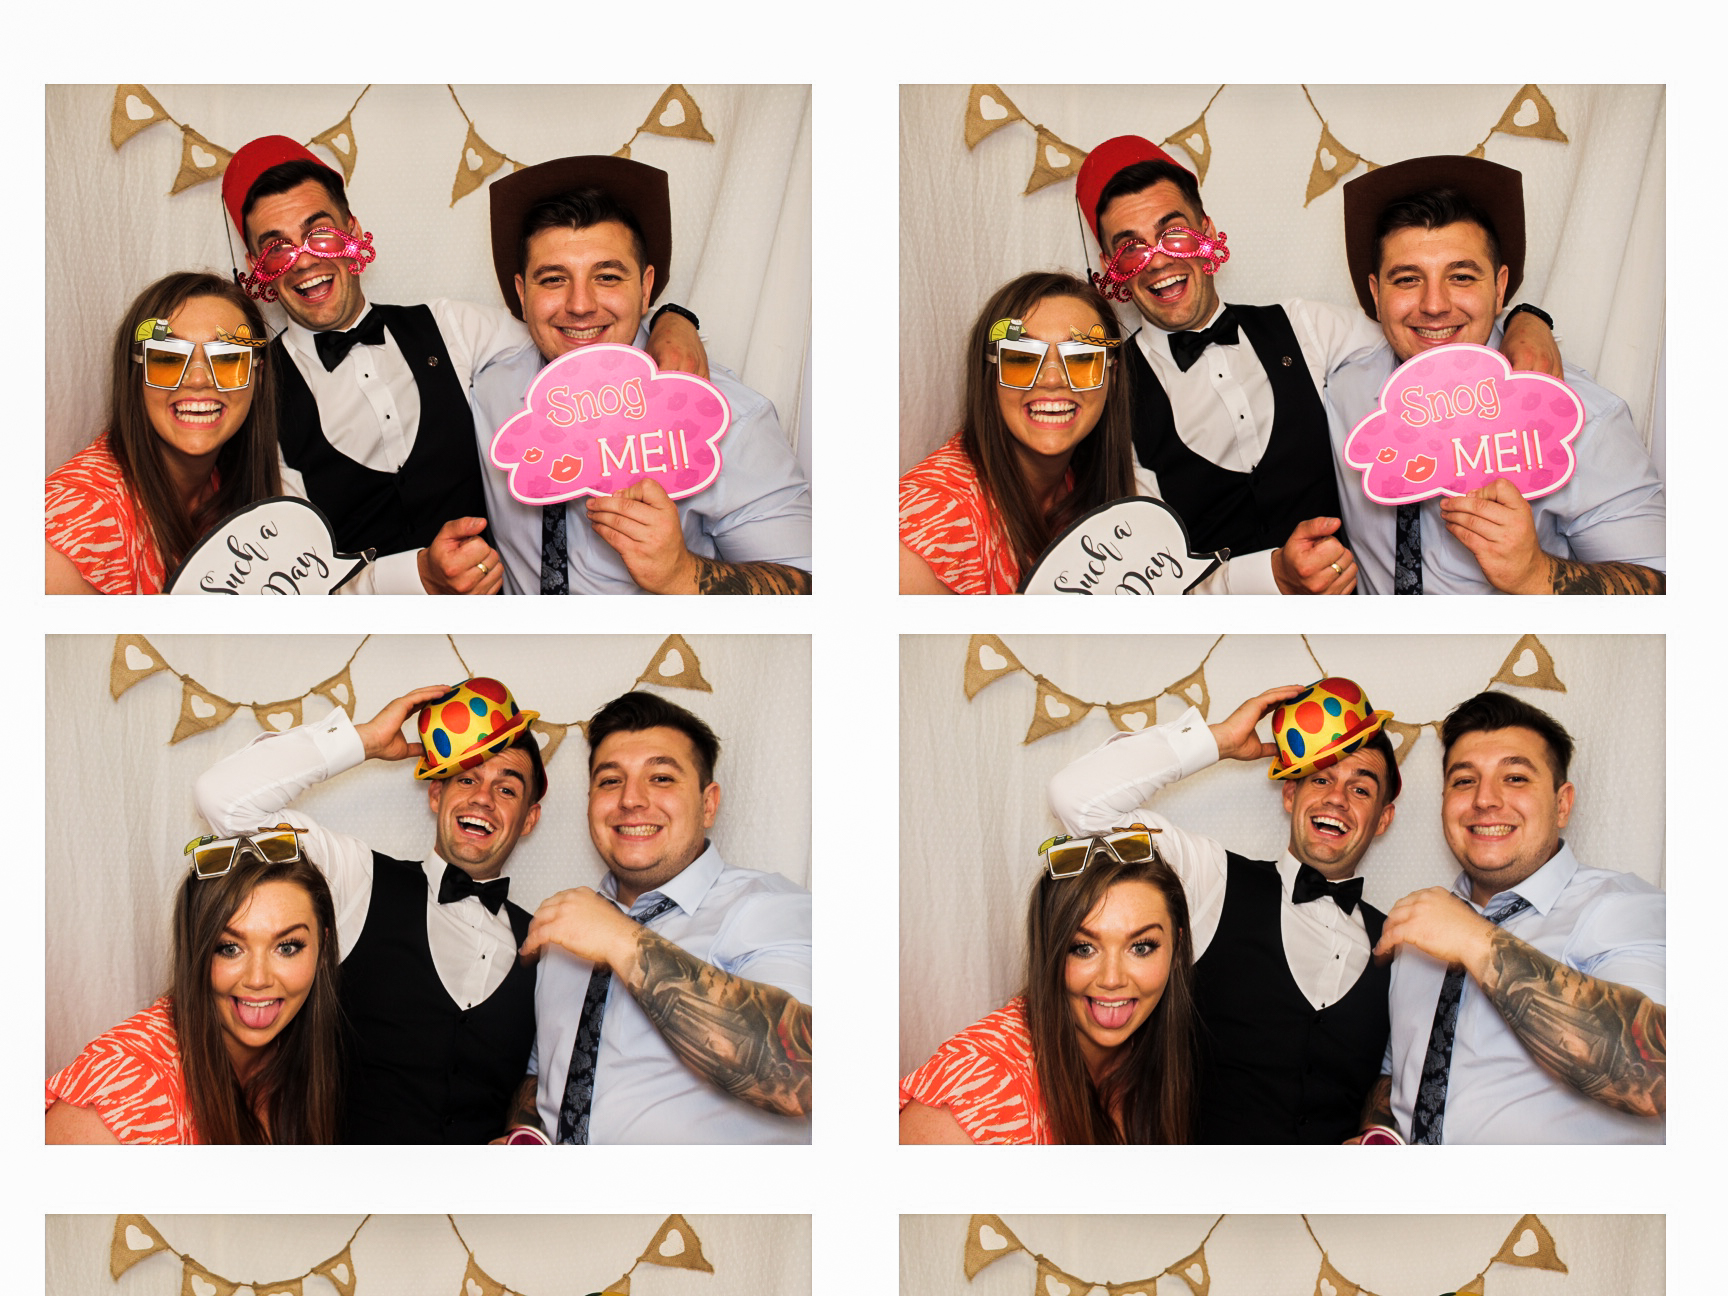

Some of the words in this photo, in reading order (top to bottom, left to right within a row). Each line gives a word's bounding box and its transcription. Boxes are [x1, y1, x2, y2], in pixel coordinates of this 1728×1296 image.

[546, 376, 648, 428] Snog
[1400, 376, 1502, 428] Snog
[597, 429, 690, 477] ME!!
[1451, 429, 1544, 477] ME!!
[200, 534, 270, 595] Such
[260, 520, 279, 540] a
[261, 546, 330, 595] Day
[1054, 534, 1124, 595] Such
[1114, 520, 1133, 540] a
[1115, 546, 1184, 595] Day
